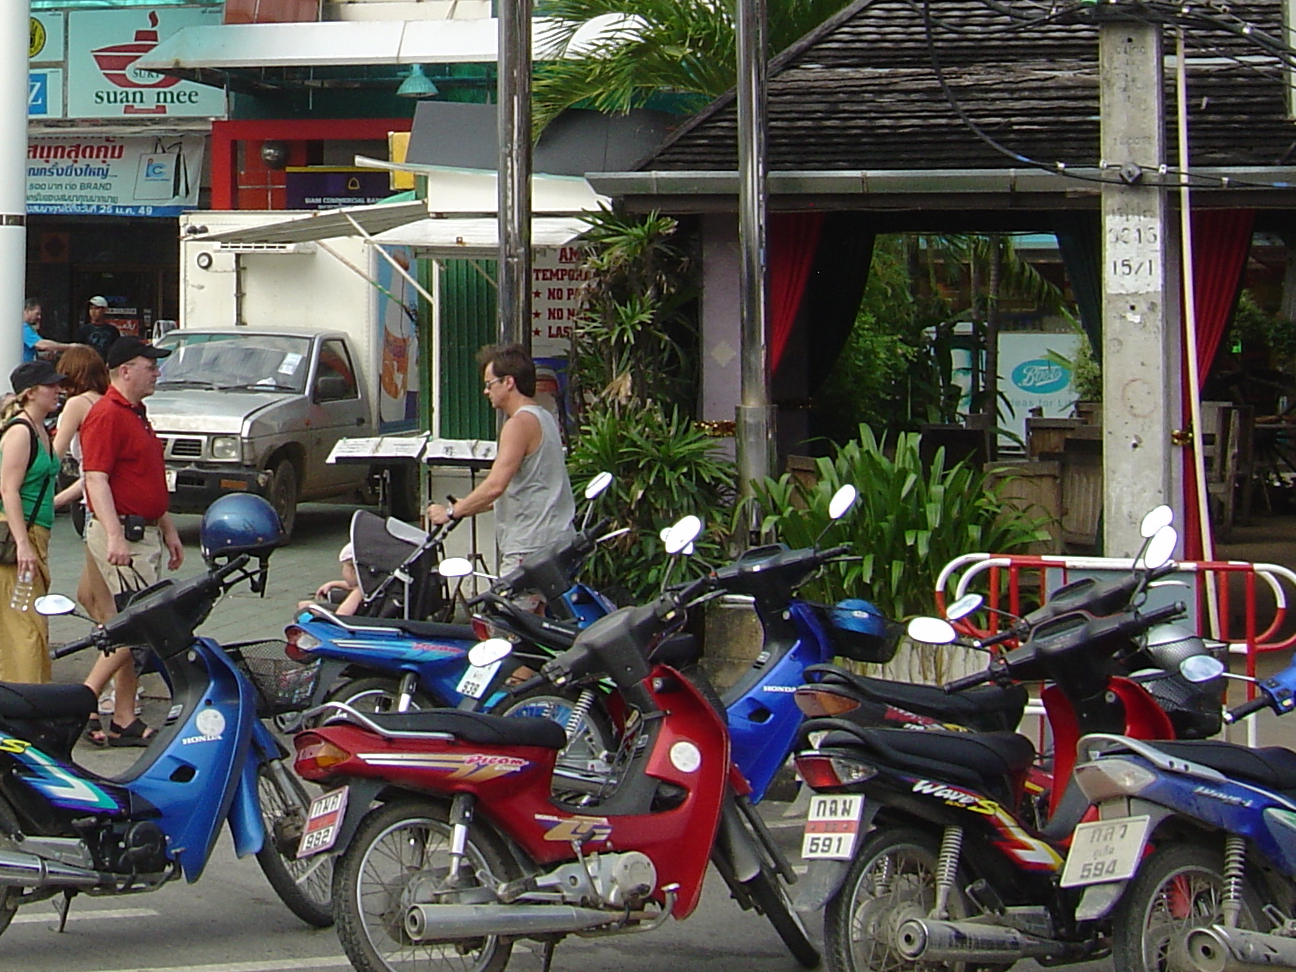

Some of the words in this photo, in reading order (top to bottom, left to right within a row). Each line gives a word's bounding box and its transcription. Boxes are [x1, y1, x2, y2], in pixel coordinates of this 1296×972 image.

[94, 88, 144, 105] suan
[155, 89, 199, 105] mee
[1112, 259, 1154, 276] 15/1
[912, 780, 979, 805] Wave
[808, 837, 843, 854] 591
[1079, 859, 1117, 879] 594
